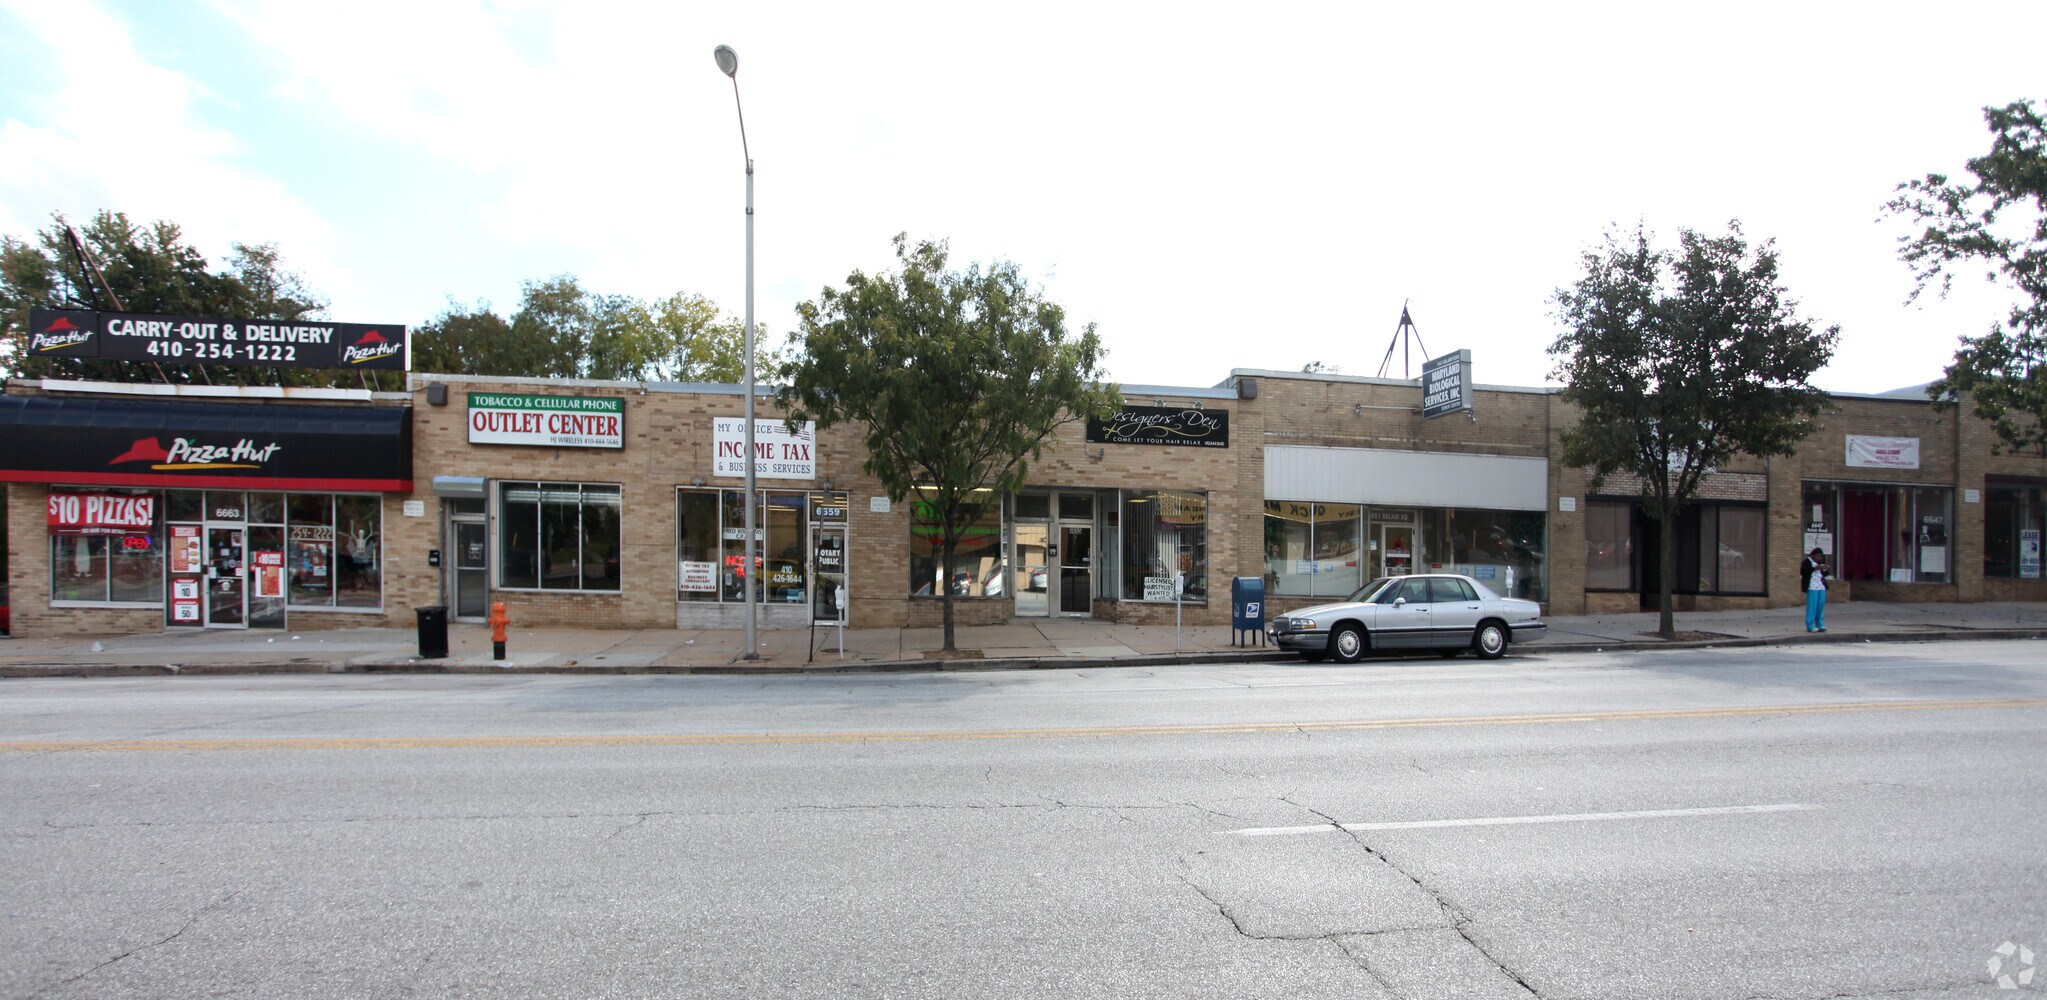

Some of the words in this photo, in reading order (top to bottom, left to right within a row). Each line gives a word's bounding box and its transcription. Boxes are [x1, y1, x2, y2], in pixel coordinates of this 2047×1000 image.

[108, 319, 218, 340] CARRY-OUT
[222, 323, 238, 340] &
[245, 325, 334, 344] DELIVERY
[31, 333, 67, 349] Pizza
[67, 330, 94, 344] Hut
[147, 340, 296, 361] 410-254-1222
[343, 346, 376, 362] Pizza
[375, 342, 402, 355] Hut
[1431, 363, 1460, 382] MARYLAND
[1429, 375, 1460, 394] BIOLOGICAL
[474, 396, 523, 407] TOBACCO
[524, 398, 532, 408] &
[534, 399, 580, 409] CELLULAR
[582, 400, 617, 411] PHONE
[472, 411, 544, 433] OUTLET
[548, 413, 619, 437] CENTER
[1181, 410, 1222, 430] Den
[718, 424, 731, 432] MY
[737, 424, 773, 434] OICE
[558, 437, 583, 445] WIRELESS
[166, 437, 230, 464] Pizza
[230, 438, 281, 462] Hut
[781, 443, 810, 461] TAX
[718, 461, 724, 471] &
[772, 463, 811, 474] SERVICES
[50, 495, 80, 524] $10
[86, 496, 154, 526] PIZZAS!
[215, 508, 240, 518] 6663
[1923, 515, 1943, 523] 6647
[2021, 531, 2038, 539] LEASE
[123, 537, 149, 549] OPEN
[725, 555, 762, 567] INCOE
[734, 567, 747, 577] TA
[781, 565, 793, 574] 410
[772, 574, 802, 583] 426-1644
